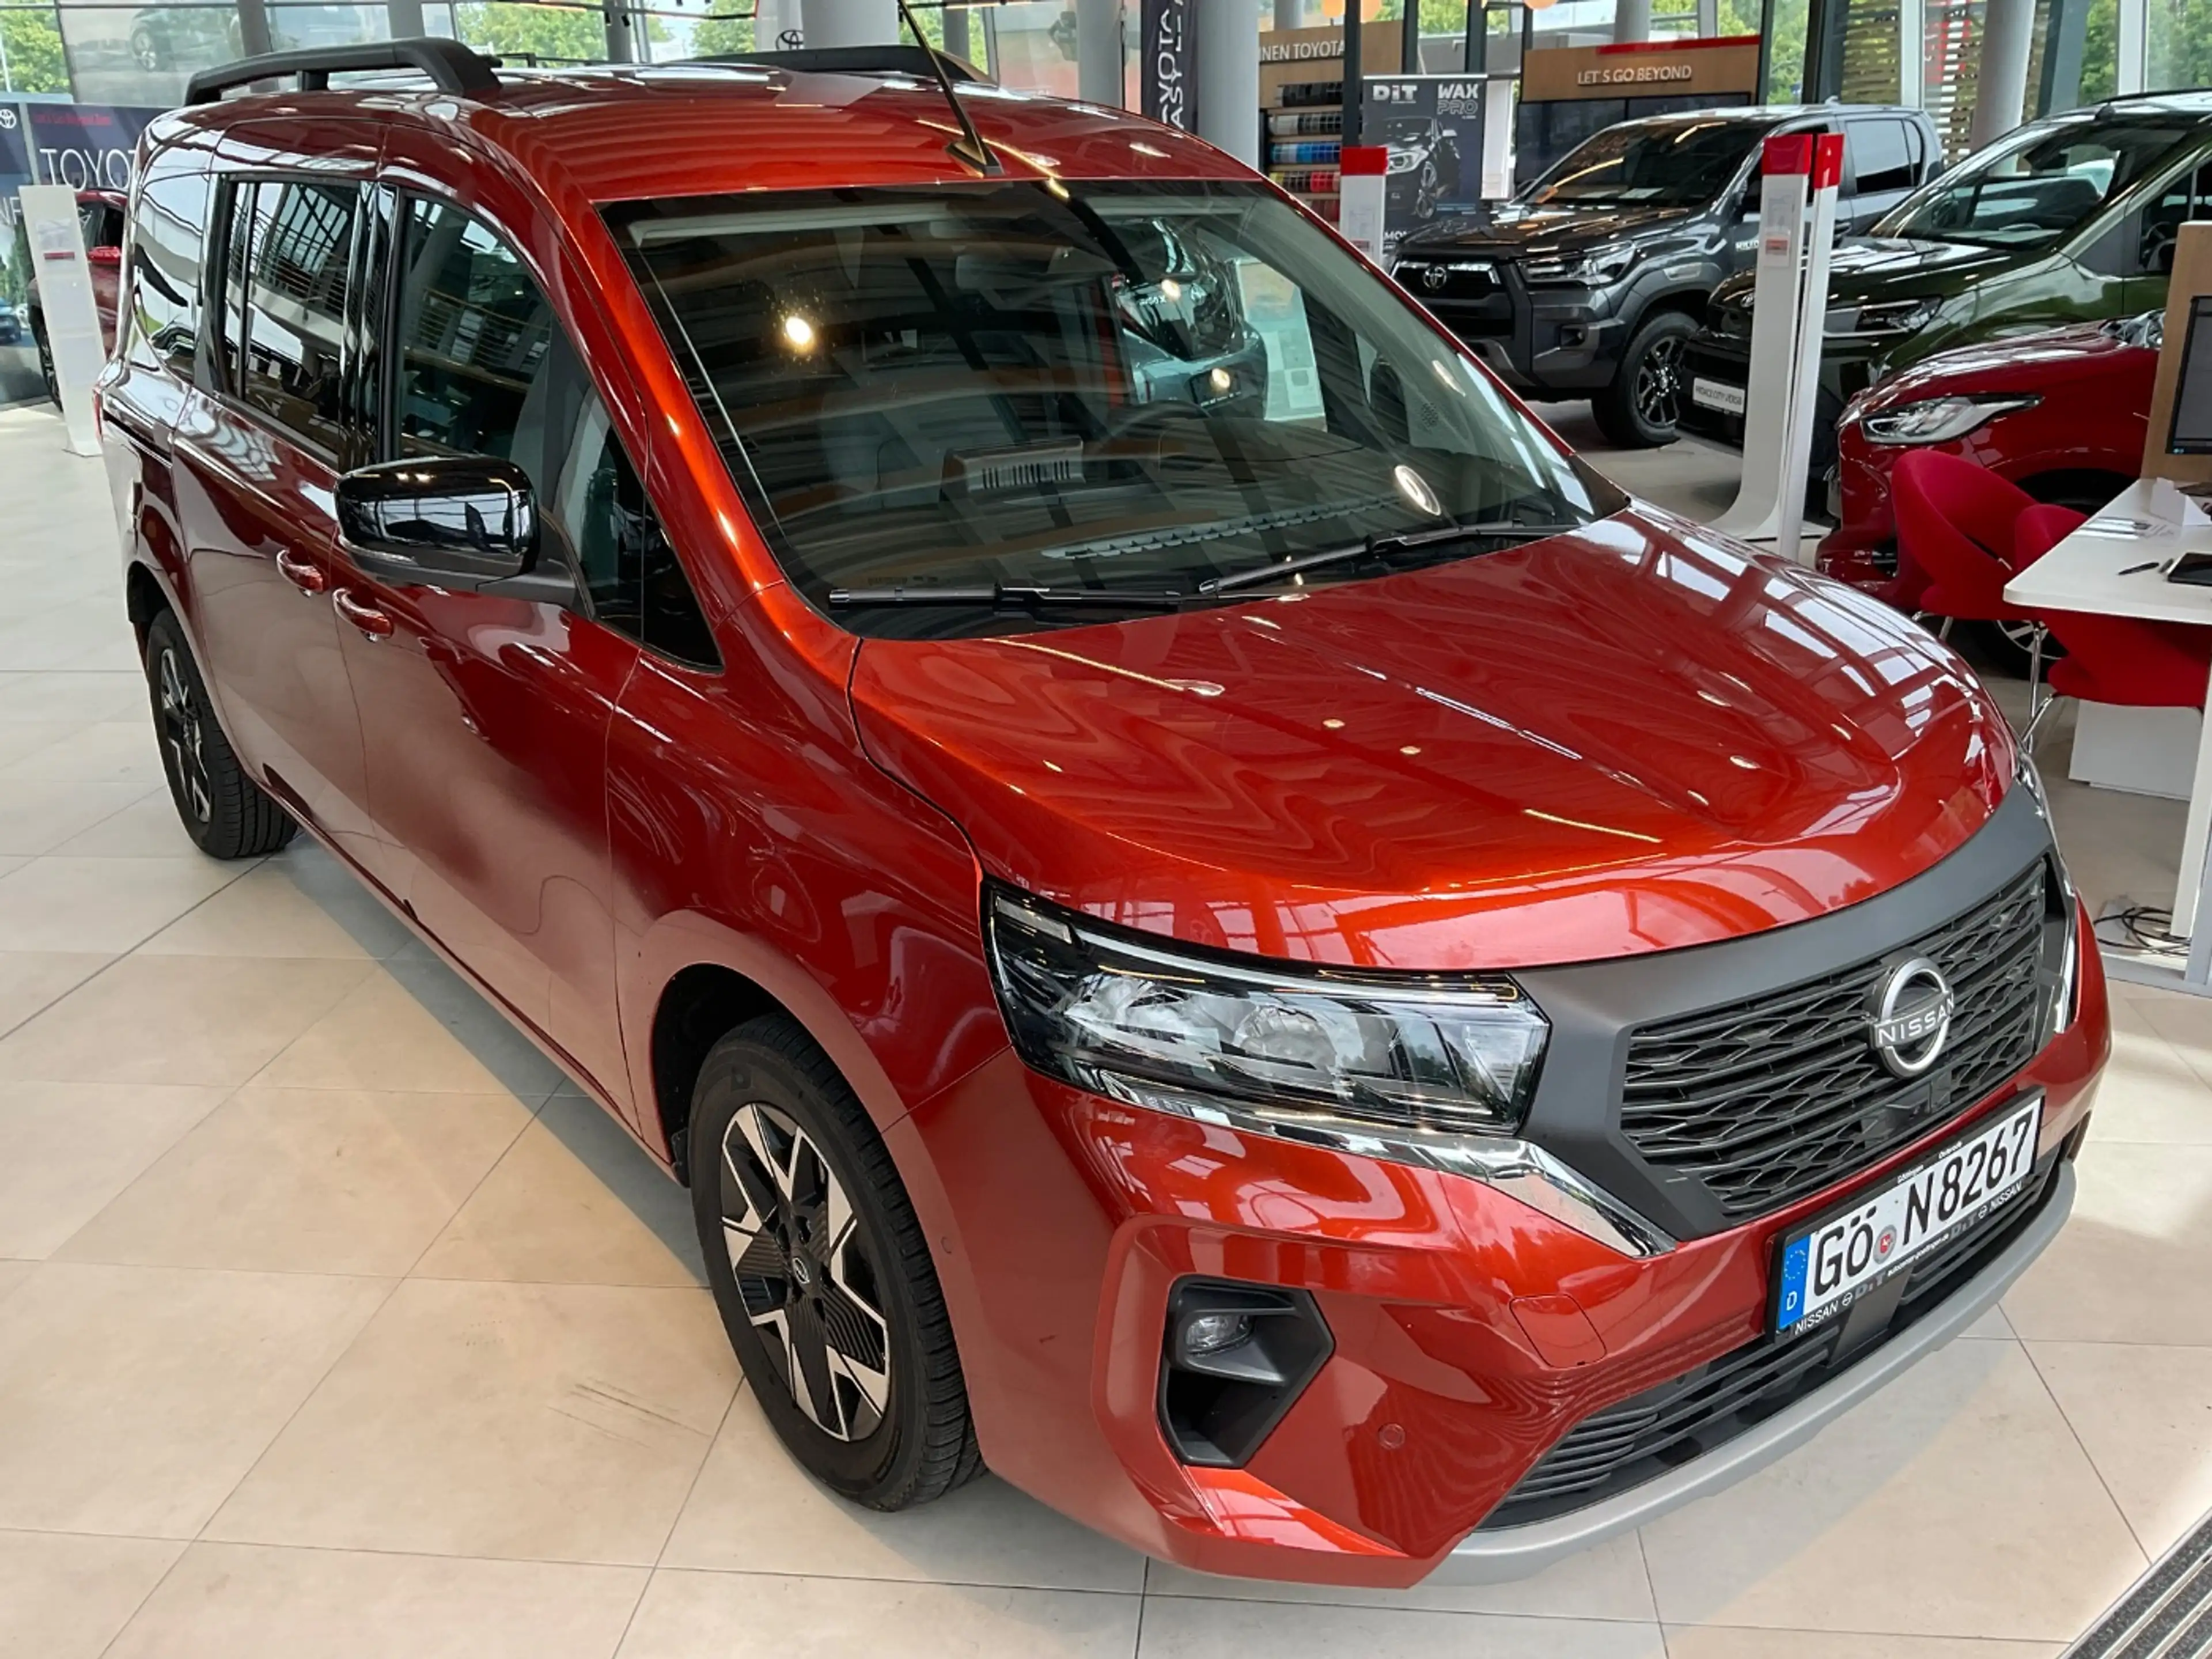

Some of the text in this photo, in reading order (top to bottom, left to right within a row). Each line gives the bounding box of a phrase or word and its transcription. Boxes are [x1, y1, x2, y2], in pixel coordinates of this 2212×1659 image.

[1260, 40, 1344, 60] NEN TOYOTA
[1613, 67, 1635, 82] GO
[1637, 65, 1692, 81] BEYOND
[1438, 83, 1478, 99] WAX
[1437, 99, 1478, 115] PRO
[40, 149, 137, 192] TOYO
[1878, 991, 1954, 1044] NISSAN
[1795, 1301, 1838, 1335] NISSAN
[1989, 1180, 2023, 1213] NISSAN
[1814, 1206, 1876, 1297] GÖ
[1786, 1291, 1798, 1310] D
